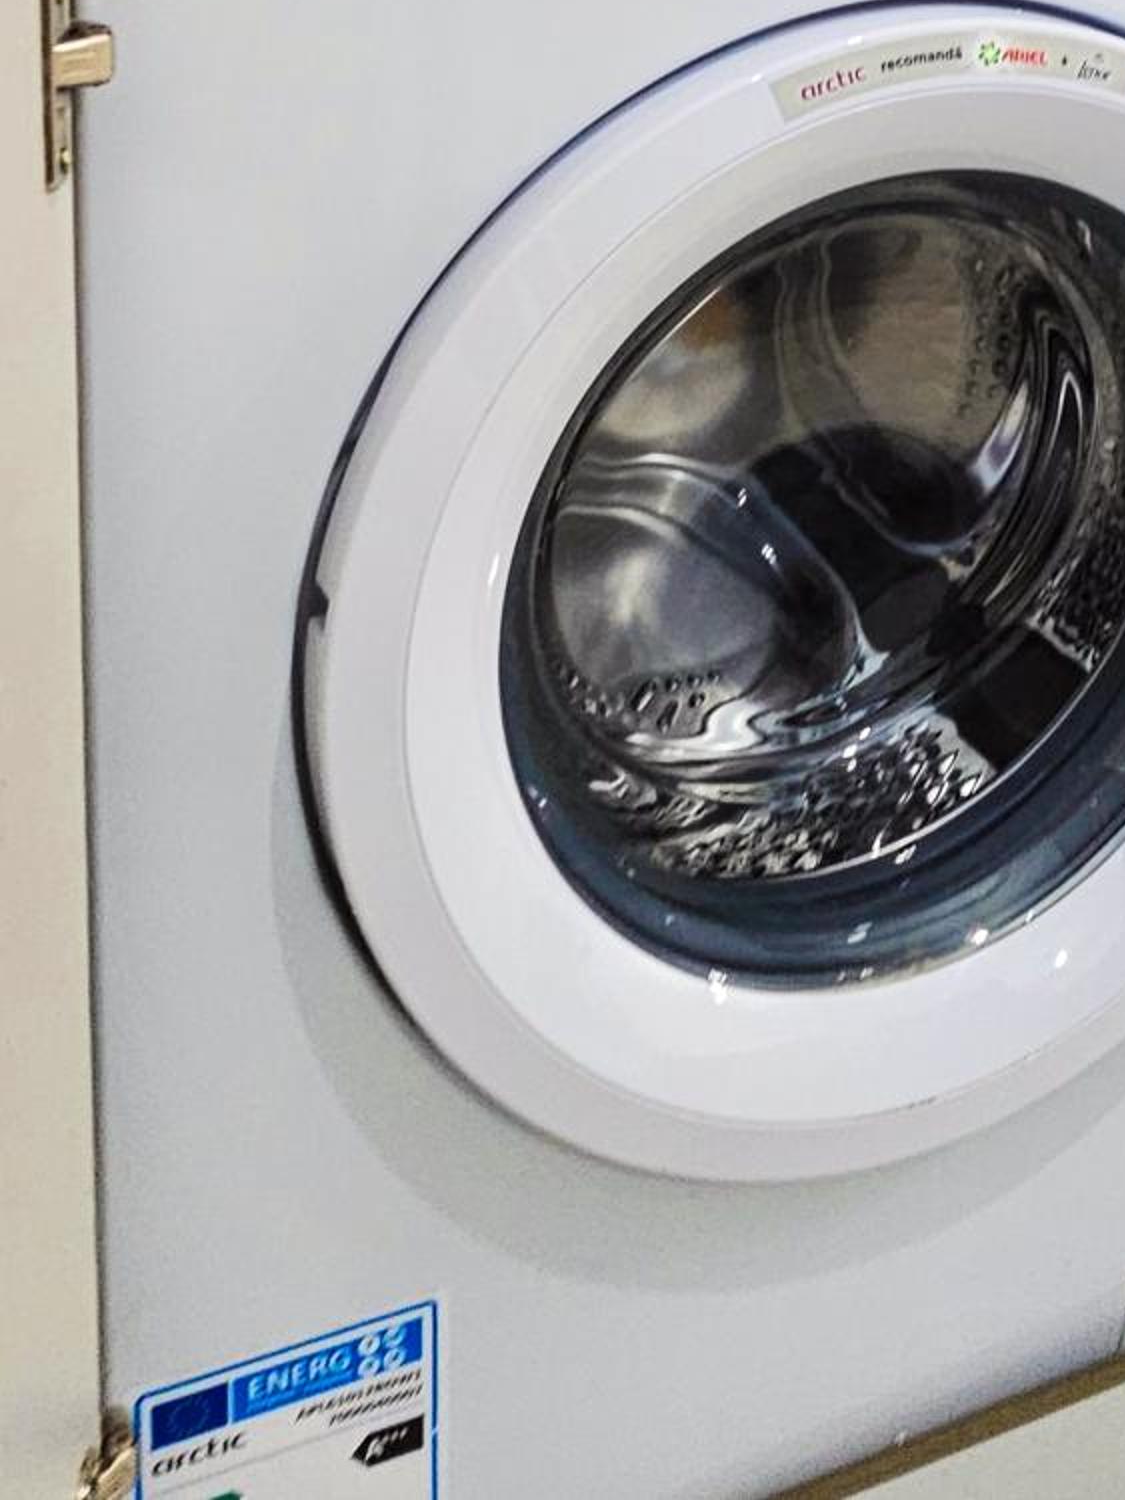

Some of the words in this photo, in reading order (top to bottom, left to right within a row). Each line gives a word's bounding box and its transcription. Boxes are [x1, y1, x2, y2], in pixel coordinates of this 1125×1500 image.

[801, 66, 866, 100] arctic
[248, 1349, 350, 1401] ENERG
[152, 1431, 247, 1476] arctic
